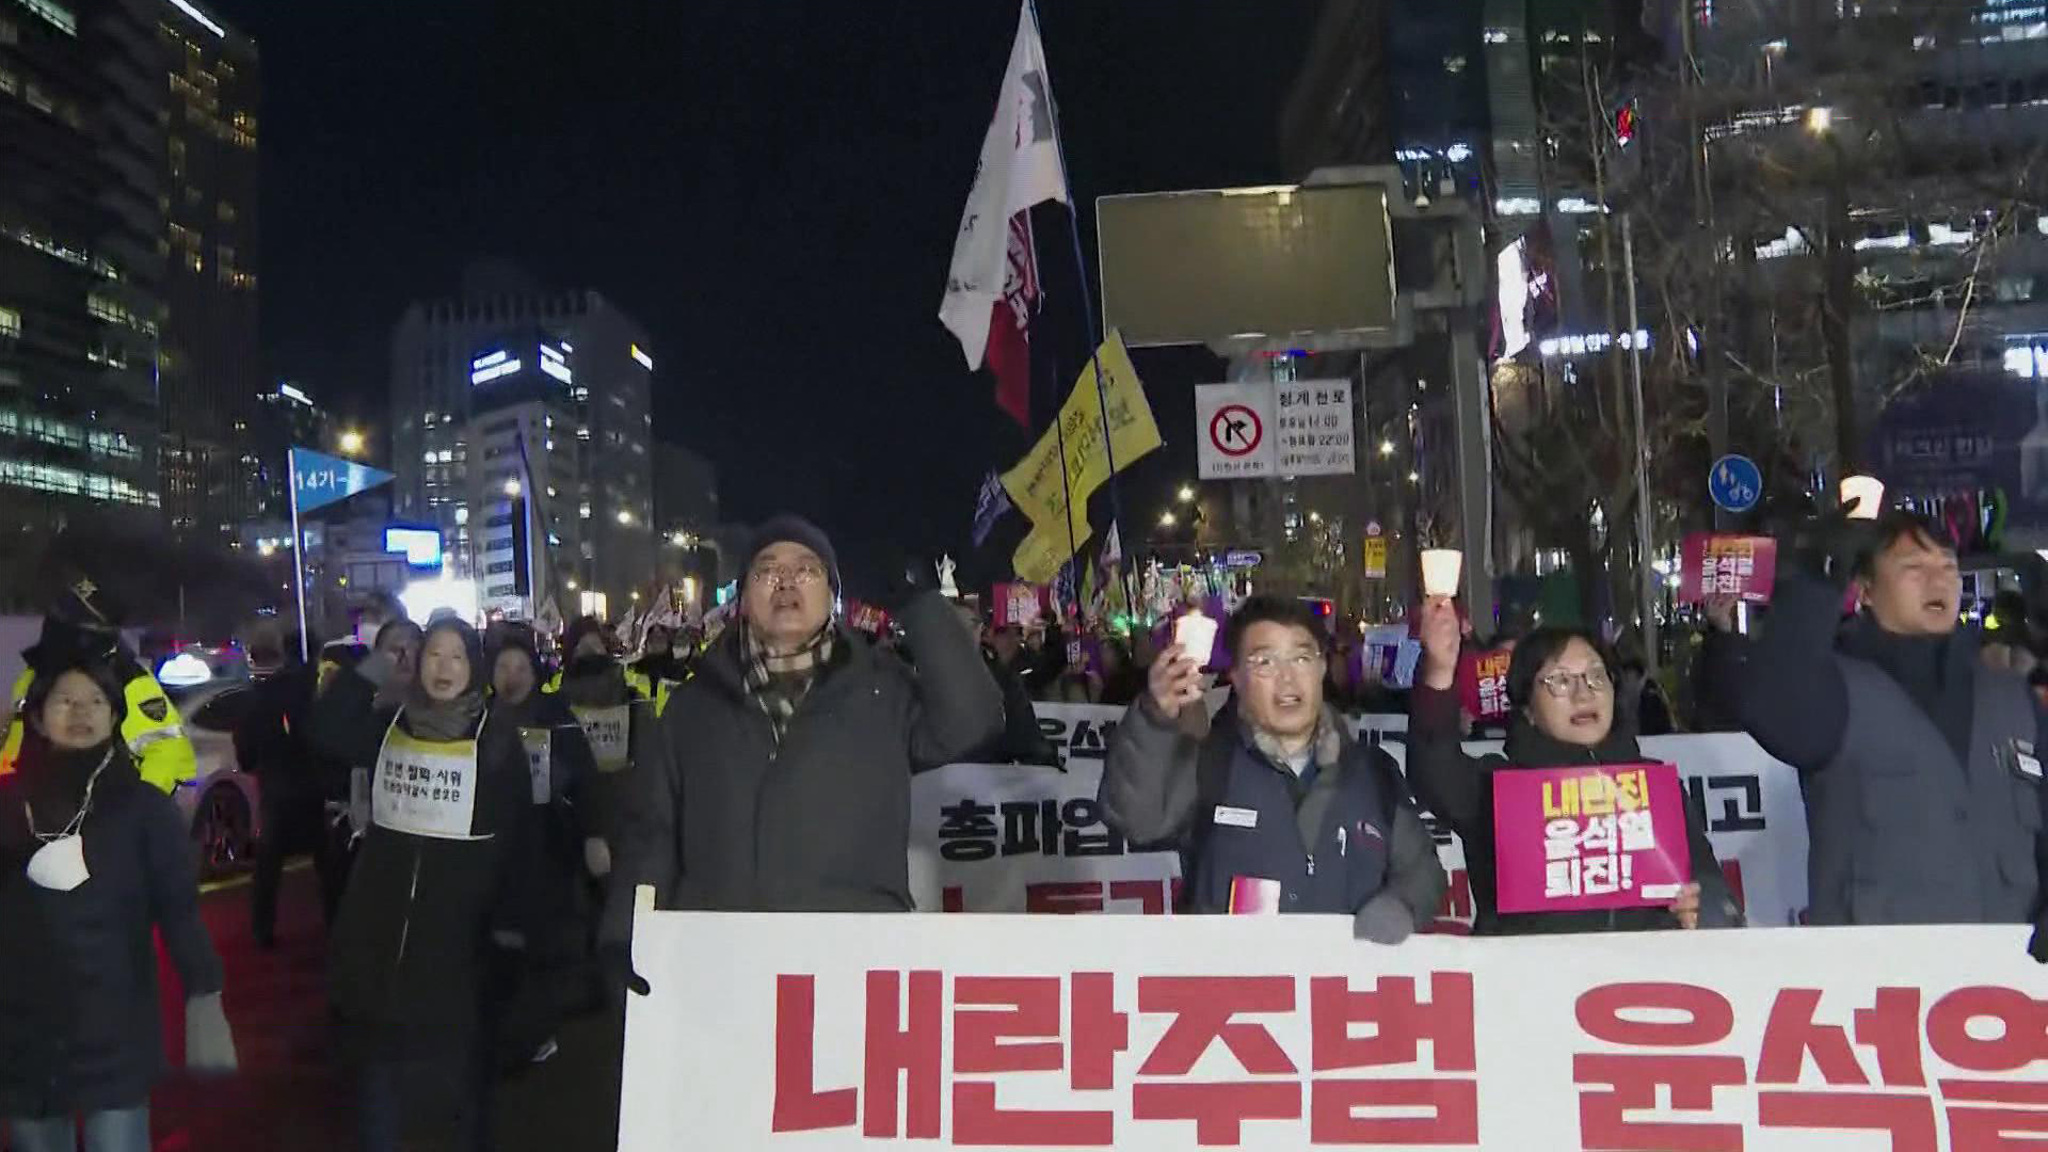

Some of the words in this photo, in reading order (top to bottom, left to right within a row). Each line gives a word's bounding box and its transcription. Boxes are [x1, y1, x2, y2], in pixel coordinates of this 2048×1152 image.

[1543, 769, 1649, 819] 내란죄
[938, 799, 1125, 862] 총파업
[1545, 810, 1656, 860] 윤석열
[1545, 851, 1633, 898] 퇴진!
[772, 969, 1480, 1147] 내란주범
[1572, 982, 2048, 1152] 윤석열
